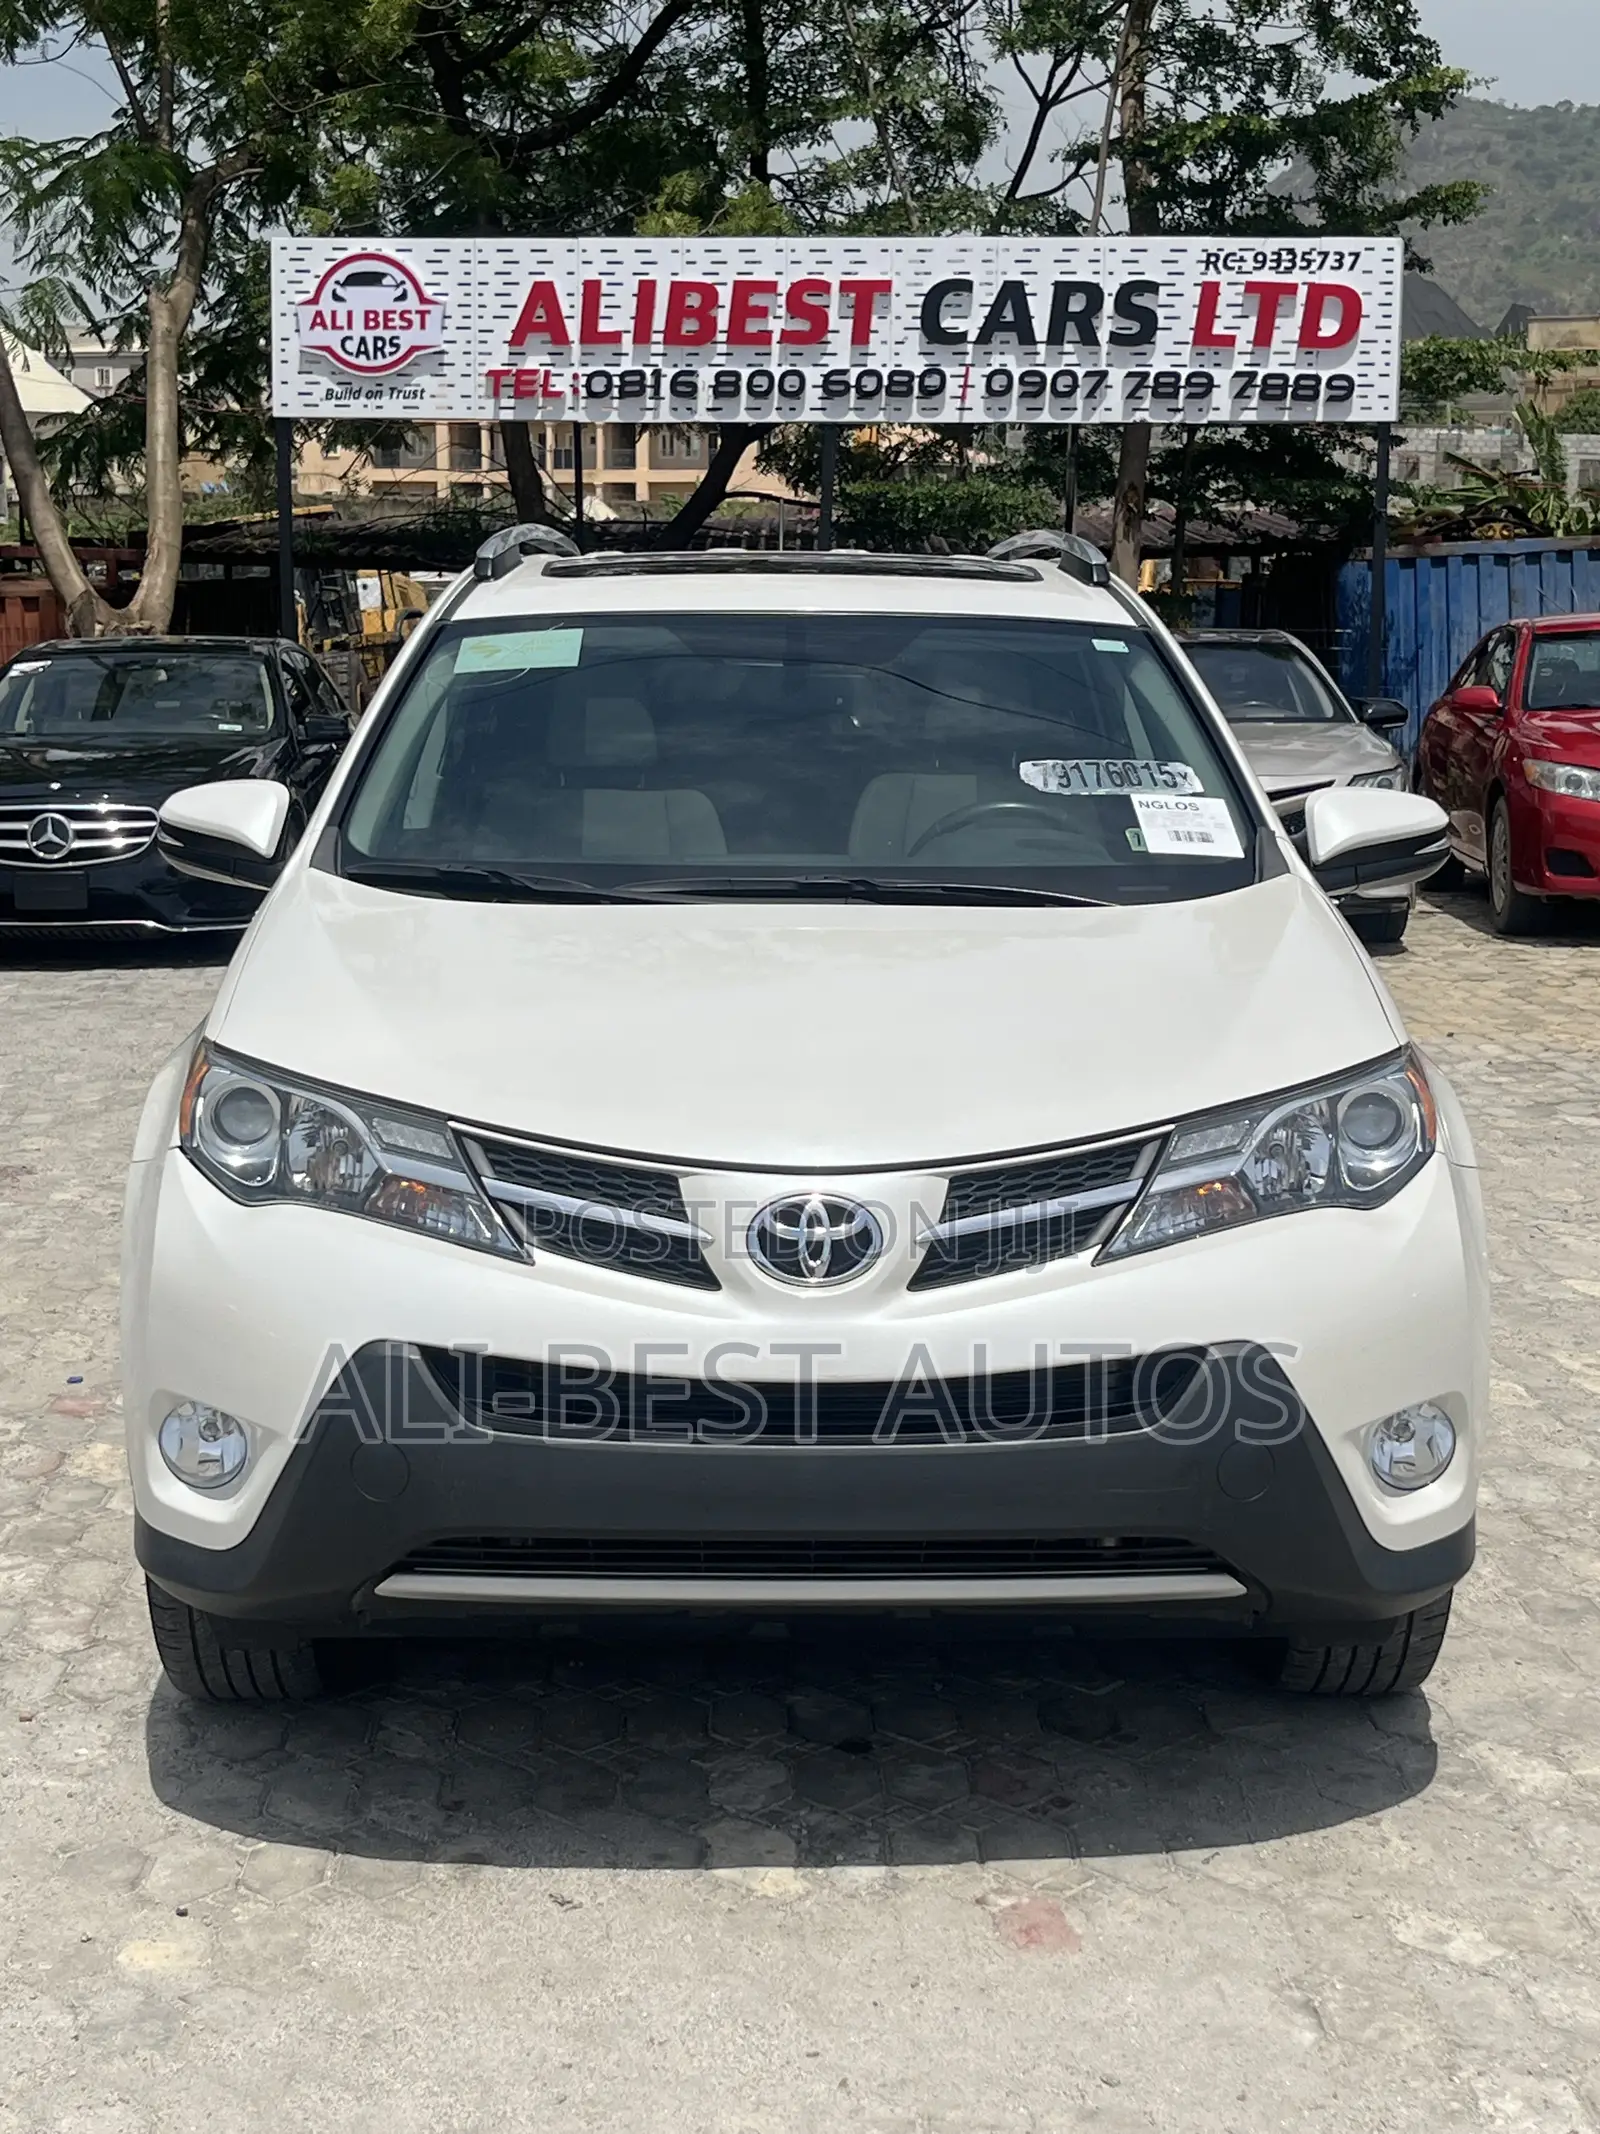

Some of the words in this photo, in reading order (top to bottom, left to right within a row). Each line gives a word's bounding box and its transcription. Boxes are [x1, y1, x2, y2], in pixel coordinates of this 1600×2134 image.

[1252, 250, 1361, 272] 9335737
[309, 310, 353, 331] ALI
[363, 310, 431, 331] BEST
[508, 279, 892, 347] ALIBEST
[920, 278, 1160, 347] CARS
[1191, 280, 1363, 349] LTD
[340, 335, 401, 361] CARS
[324, 387, 362, 401] Build
[364, 389, 384, 401] on
[388, 386, 426, 400] Trust
[584, 368, 699, 399] 0816
[713, 369, 807, 399] 800
[823, 368, 947, 398] 6080
[985, 368, 1108, 398] 0907
[1124, 370, 1215, 400] 789
[1230, 370, 1356, 401] 7889
[1138, 800, 1200, 812] NGLOS
